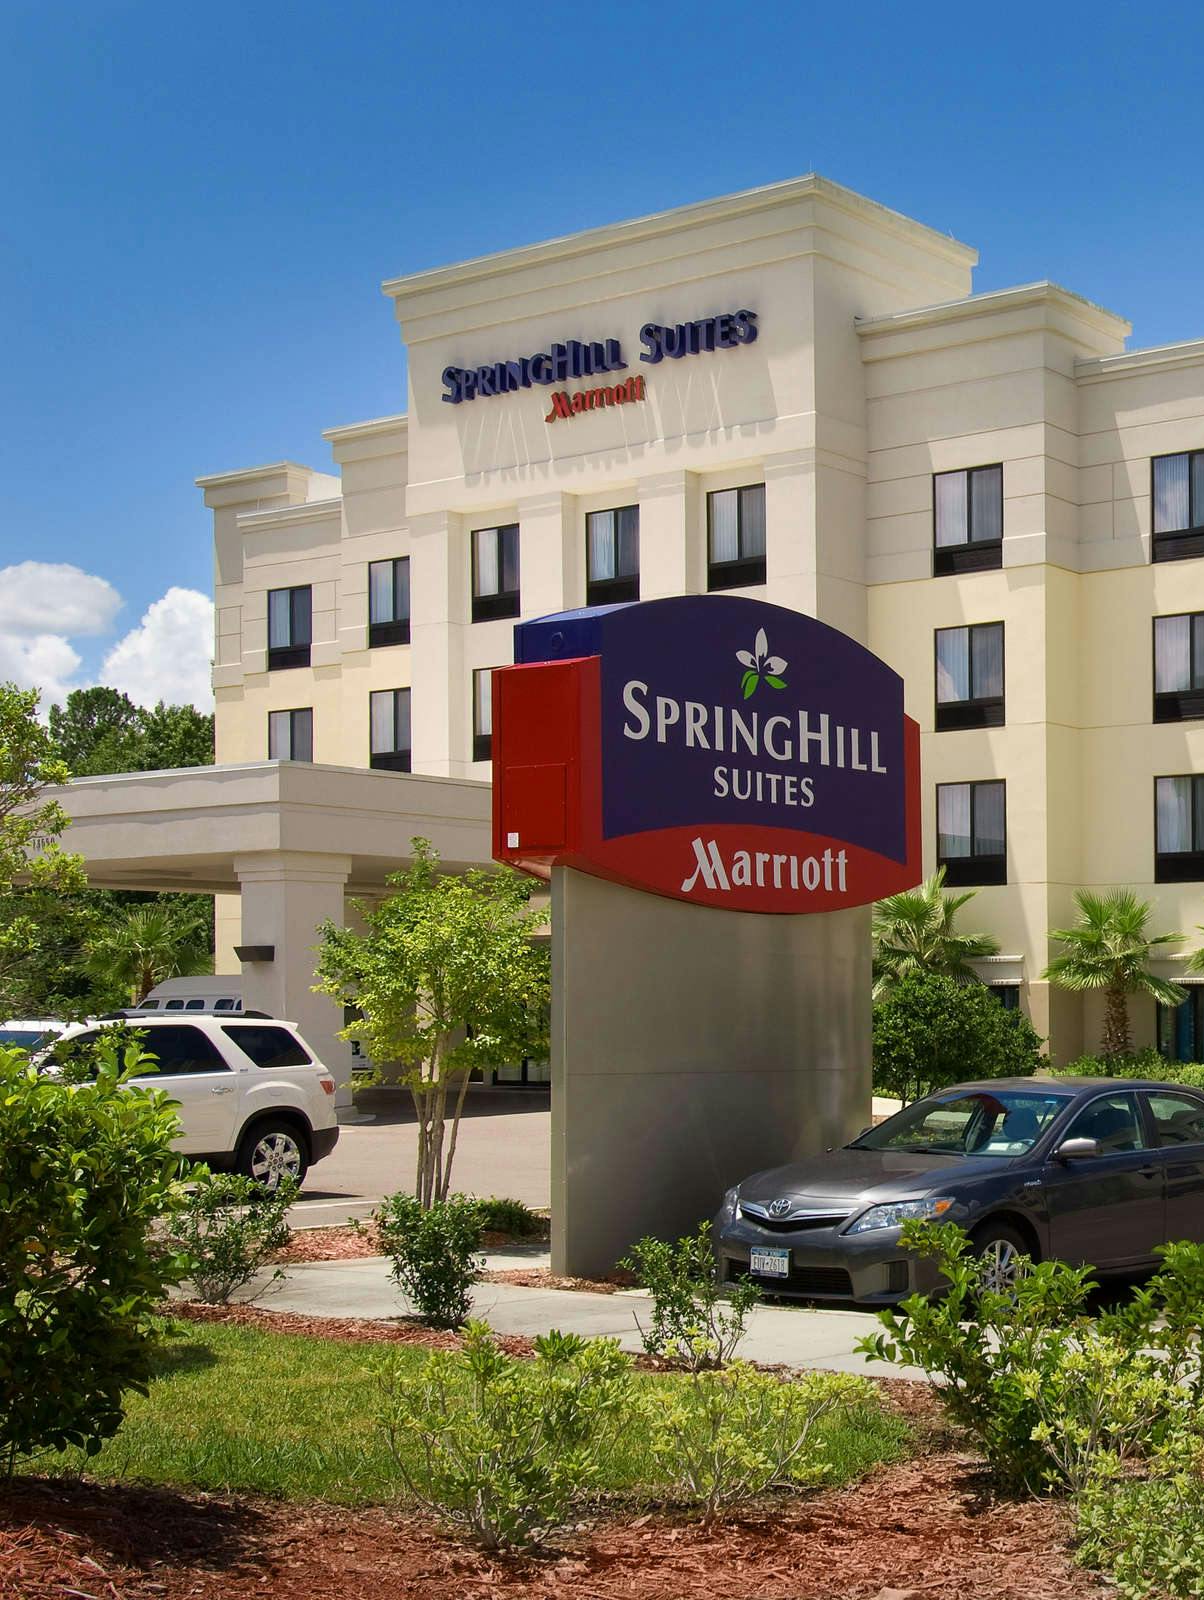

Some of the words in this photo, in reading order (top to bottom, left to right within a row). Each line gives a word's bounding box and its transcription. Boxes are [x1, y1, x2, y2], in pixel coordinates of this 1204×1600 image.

[442, 338, 628, 404] SPRINGHILL
[640, 309, 758, 364] SUITES
[545, 374, 648, 423] Marriott
[623, 680, 887, 774] SPRINGHILL
[714, 765, 815, 808] SUITES
[681, 837, 848, 892] Marriott
